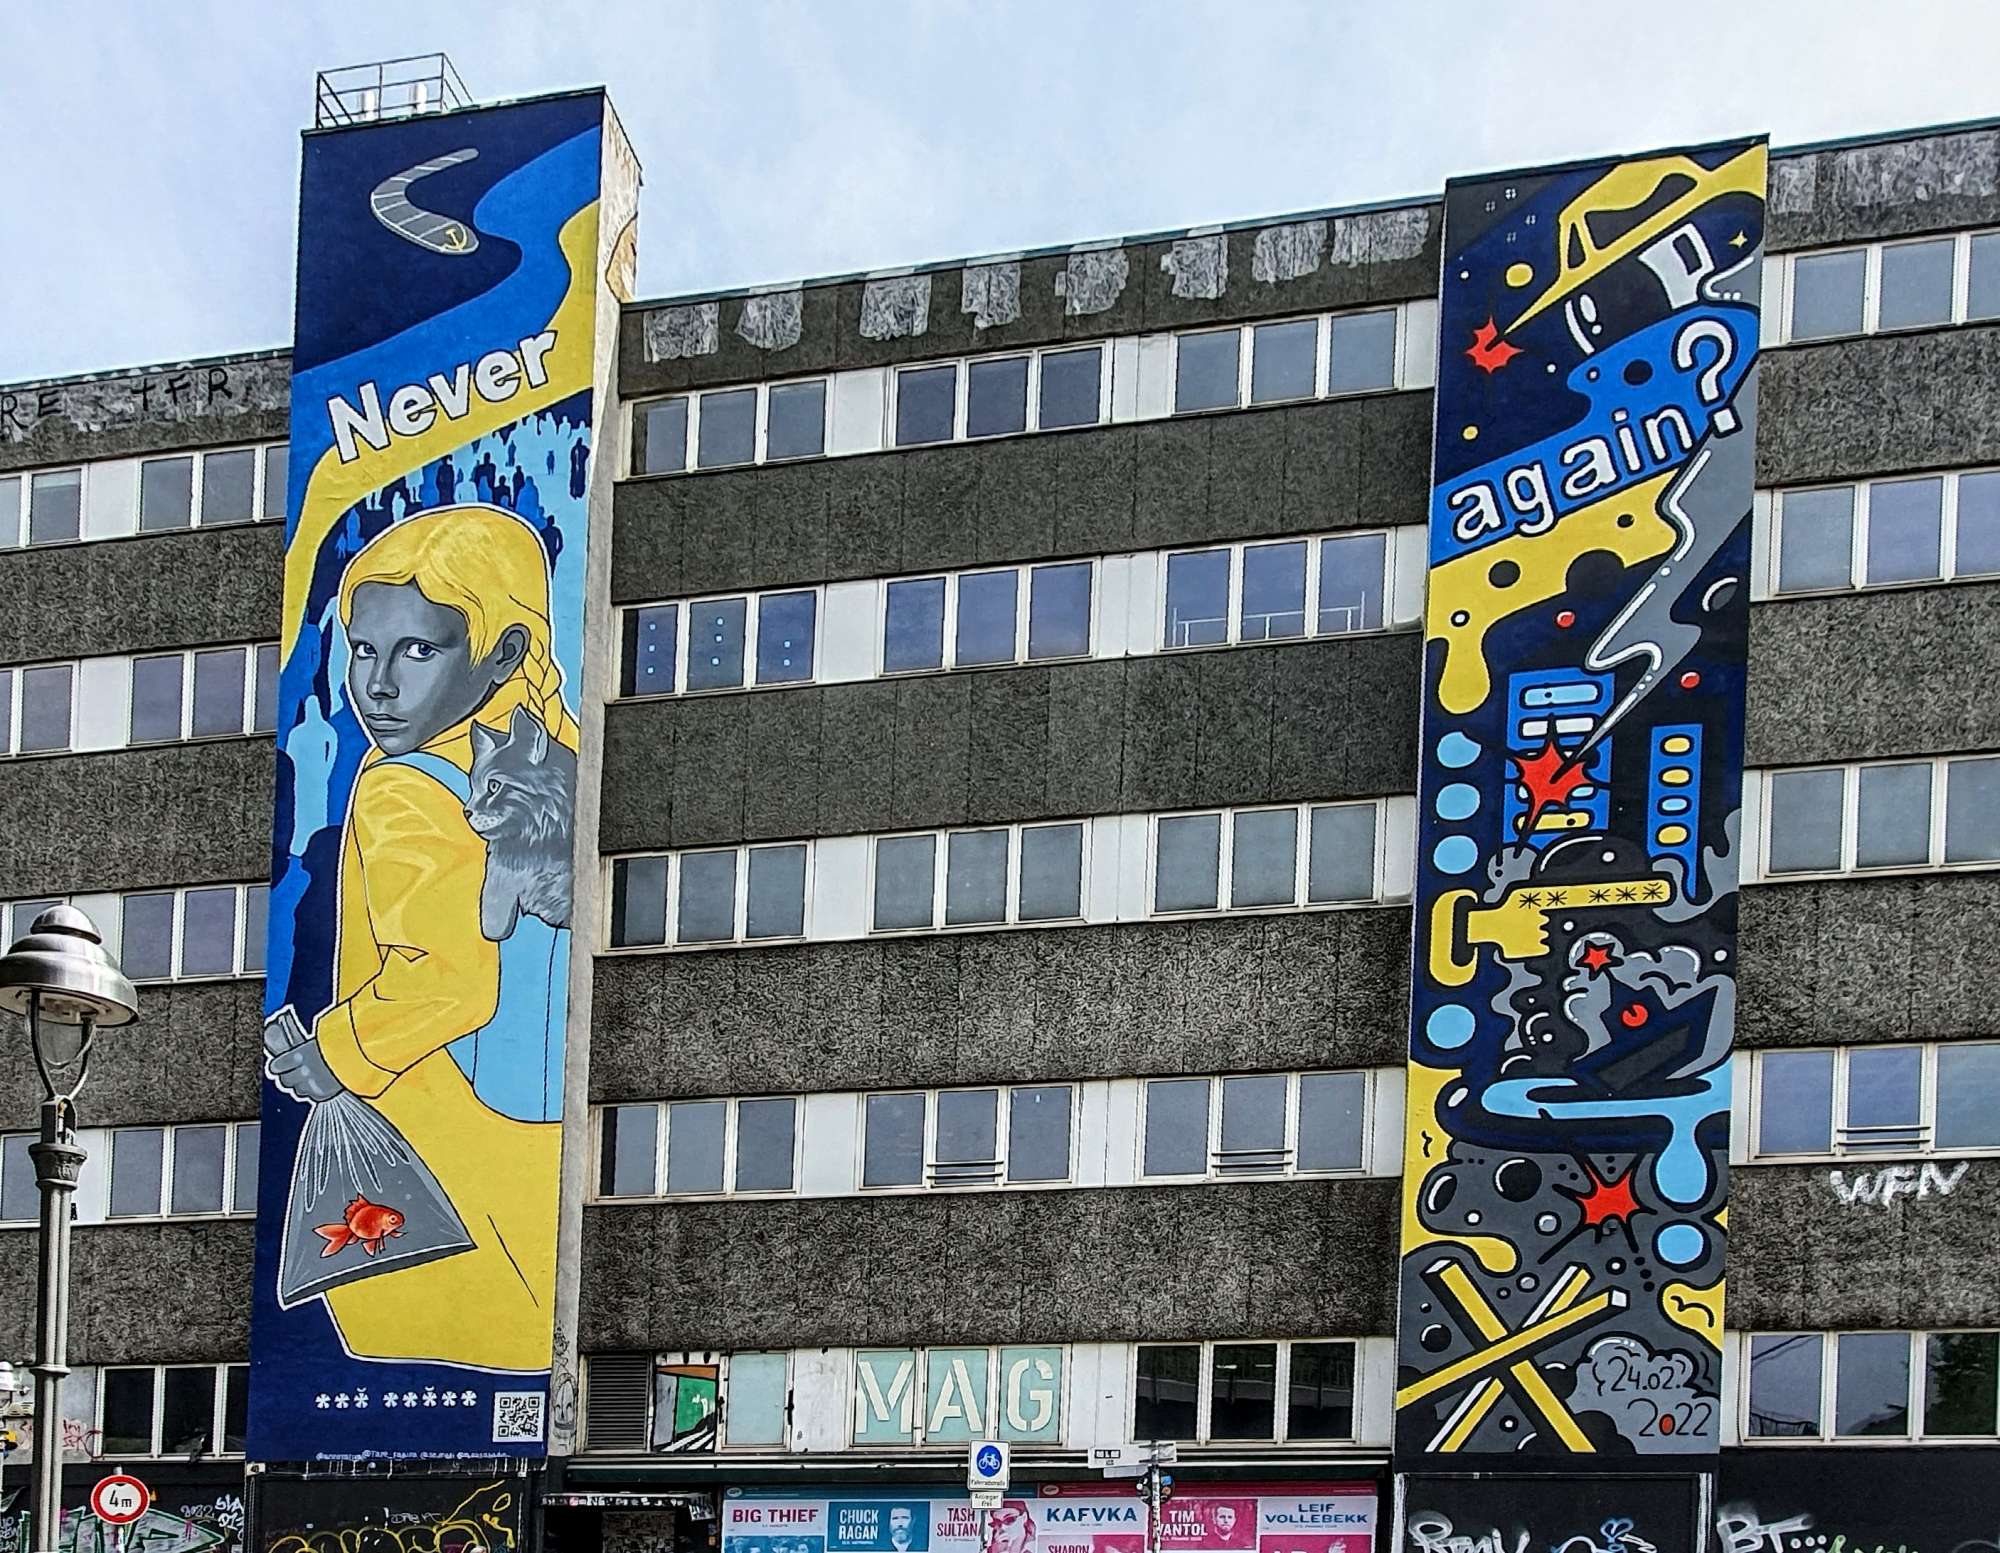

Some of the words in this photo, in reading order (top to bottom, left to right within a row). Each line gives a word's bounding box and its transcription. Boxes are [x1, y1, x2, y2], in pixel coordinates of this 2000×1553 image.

[328, 330, 558, 465] Never
[1450, 317, 1738, 541] again?
[855, 1357, 1054, 1434] MAG
[1626, 1397, 1713, 1437] 2022
[109, 1490, 119, 1507] 4
[121, 1498, 132, 1507] m
[947, 1508, 976, 1521] TASH
[1046, 1507, 1138, 1522] KAFVKA
[1298, 1503, 1336, 1513] LEIF
[732, 1509, 762, 1523] BIG
[767, 1509, 819, 1523] THIEF
[839, 1509, 879, 1524] CHUCK
[1169, 1511, 1195, 1523] TIM
[1265, 1514, 1369, 1524] VOLLEBEKK
[838, 1526, 879, 1540] RAGAN
